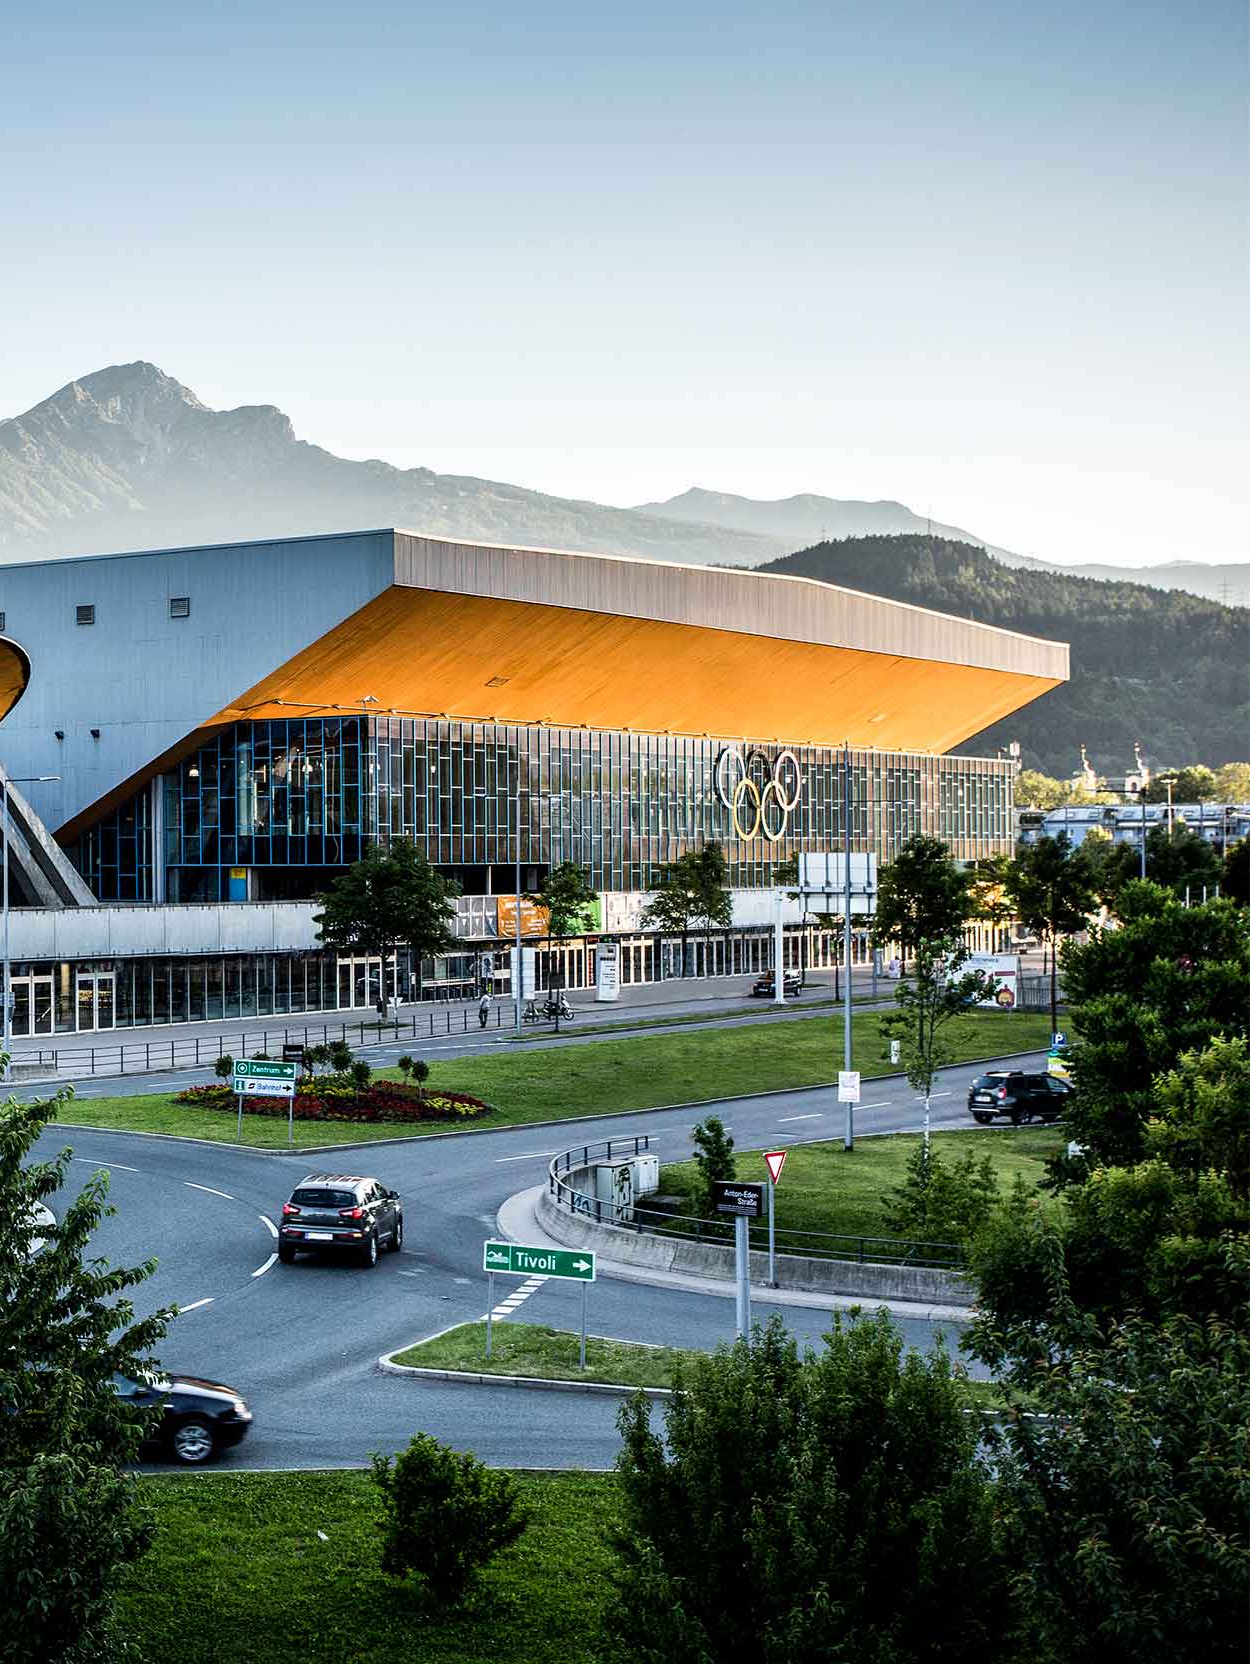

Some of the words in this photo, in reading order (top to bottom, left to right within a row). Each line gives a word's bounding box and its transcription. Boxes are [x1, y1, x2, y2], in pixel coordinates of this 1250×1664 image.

[252, 1065, 281, 1074] Zentrum
[256, 1083, 282, 1091] Bahnhof
[515, 1251, 556, 1270] Tivoli
